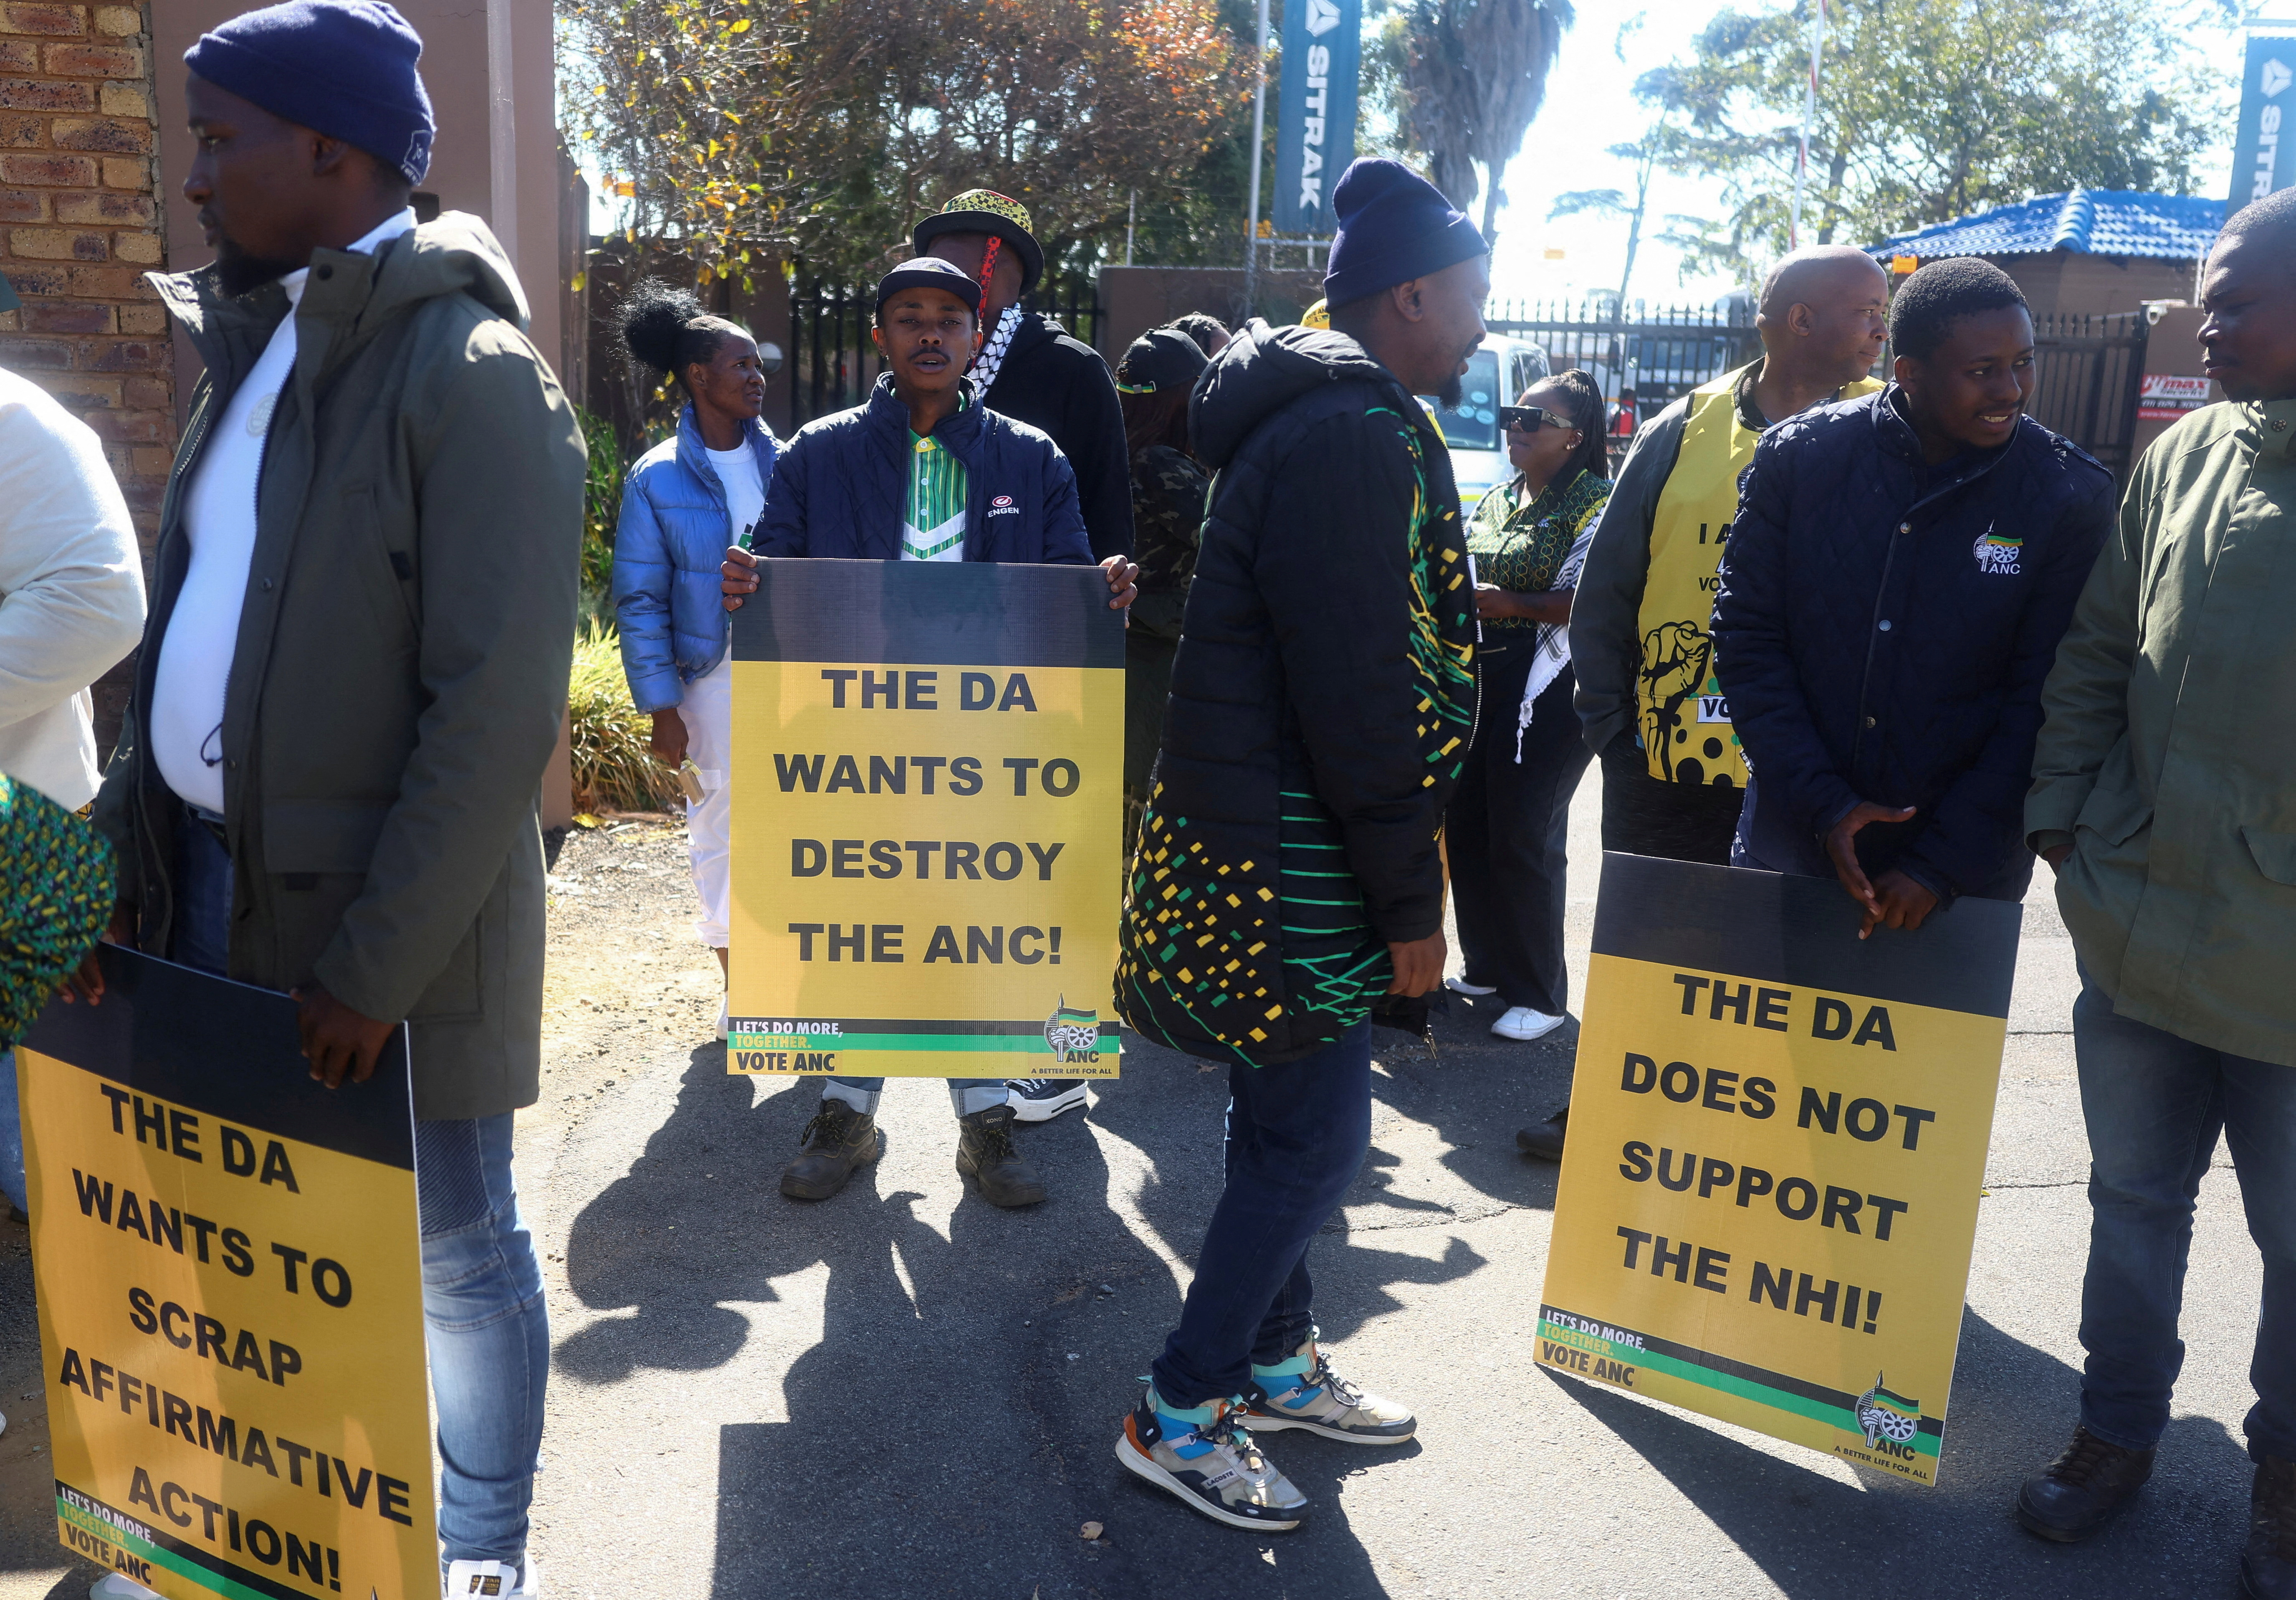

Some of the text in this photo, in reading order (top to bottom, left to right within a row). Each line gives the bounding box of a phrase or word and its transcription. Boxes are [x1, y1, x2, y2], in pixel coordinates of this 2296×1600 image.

[1299, 44, 1330, 210] SITRAK
[2250, 104, 2282, 204] SITR
[988, 507, 1019, 518] ENGEN
[1714, 523, 1732, 544] A
[1699, 577, 1720, 592] VO
[1988, 563, 2020, 574] ANC
[821, 669, 1038, 712] THE DA
[1703, 698, 1730, 718] VO
[773, 754, 1080, 797] WANTS TO
[791, 838, 1066, 881] DESTROY
[788, 923, 1062, 965] THE ANC!
[736, 1021, 843, 1038] LET'S DO MORE,
[1673, 973, 1897, 1052] THE DA
[735, 1035, 812, 1048] TOGETHER.
[736, 1052, 835, 1072] VOTE ANC
[1065, 1050, 1100, 1063] ANC
[1621, 1052, 1936, 1151] DOES NOT
[100, 1083, 300, 1194] THE DA
[1619, 1141, 1909, 1242] SUPPORT
[72, 1168, 352, 1308] WANTS TO
[1616, 1225, 1882, 1335] THE NHI!
[128, 1287, 302, 1387] SCRAP
[1544, 1324, 1614, 1356] TOGETHER.
[1546, 1310, 1646, 1354] LET'S DO MORE,
[1542, 1340, 1635, 1387] VOTE ANC
[59, 1347, 413, 1527] AFFIRMATIVE
[1875, 1438, 1916, 1461] ANC
[1206, 1471, 1234, 1486] LACOSTE
[1843, 1448, 1871, 1462] BETTER
[1874, 1457, 1890, 1468] LIFE
[1893, 1463, 1910, 1474] FOR
[1912, 1470, 1928, 1479] ALL
[62, 1487, 155, 1549] LET'S DO MORE,
[63, 1502, 129, 1548] TOGETHER.
[127, 1466, 341, 1593] ACTION!
[65, 1522, 152, 1585] VOTE ANC
